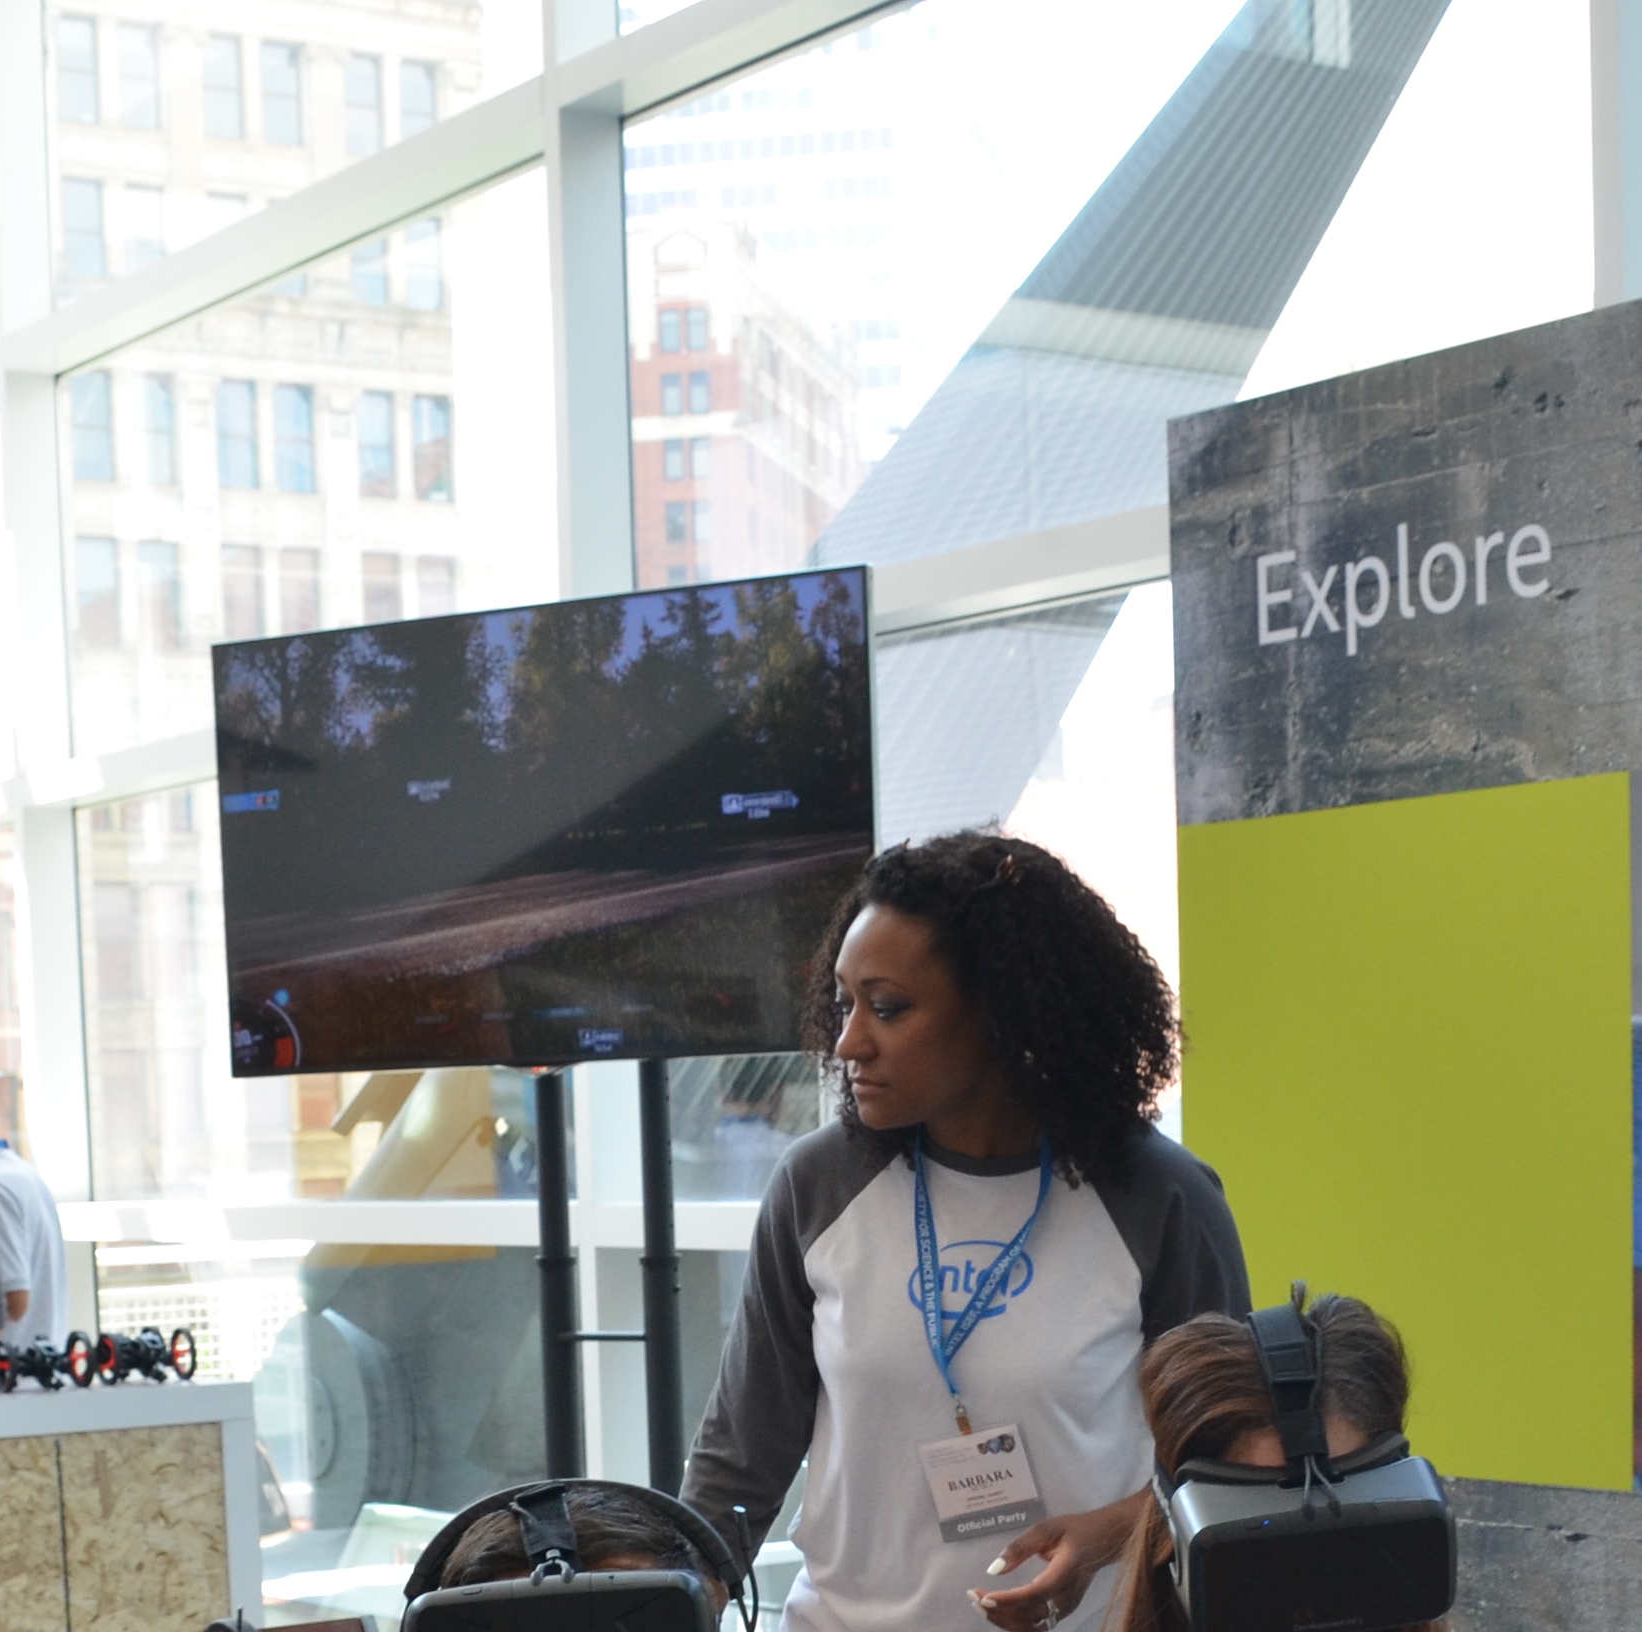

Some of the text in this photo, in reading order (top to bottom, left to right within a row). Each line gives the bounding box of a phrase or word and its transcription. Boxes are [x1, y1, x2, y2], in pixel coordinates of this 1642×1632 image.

[1257, 522, 1552, 656] Explore
[920, 1236, 934, 1283] SCIENCE
[980, 1256, 1012, 1301] PROGRAM
[948, 1469, 1014, 1492] BARBARA
[957, 1511, 1027, 1533] Official Party
